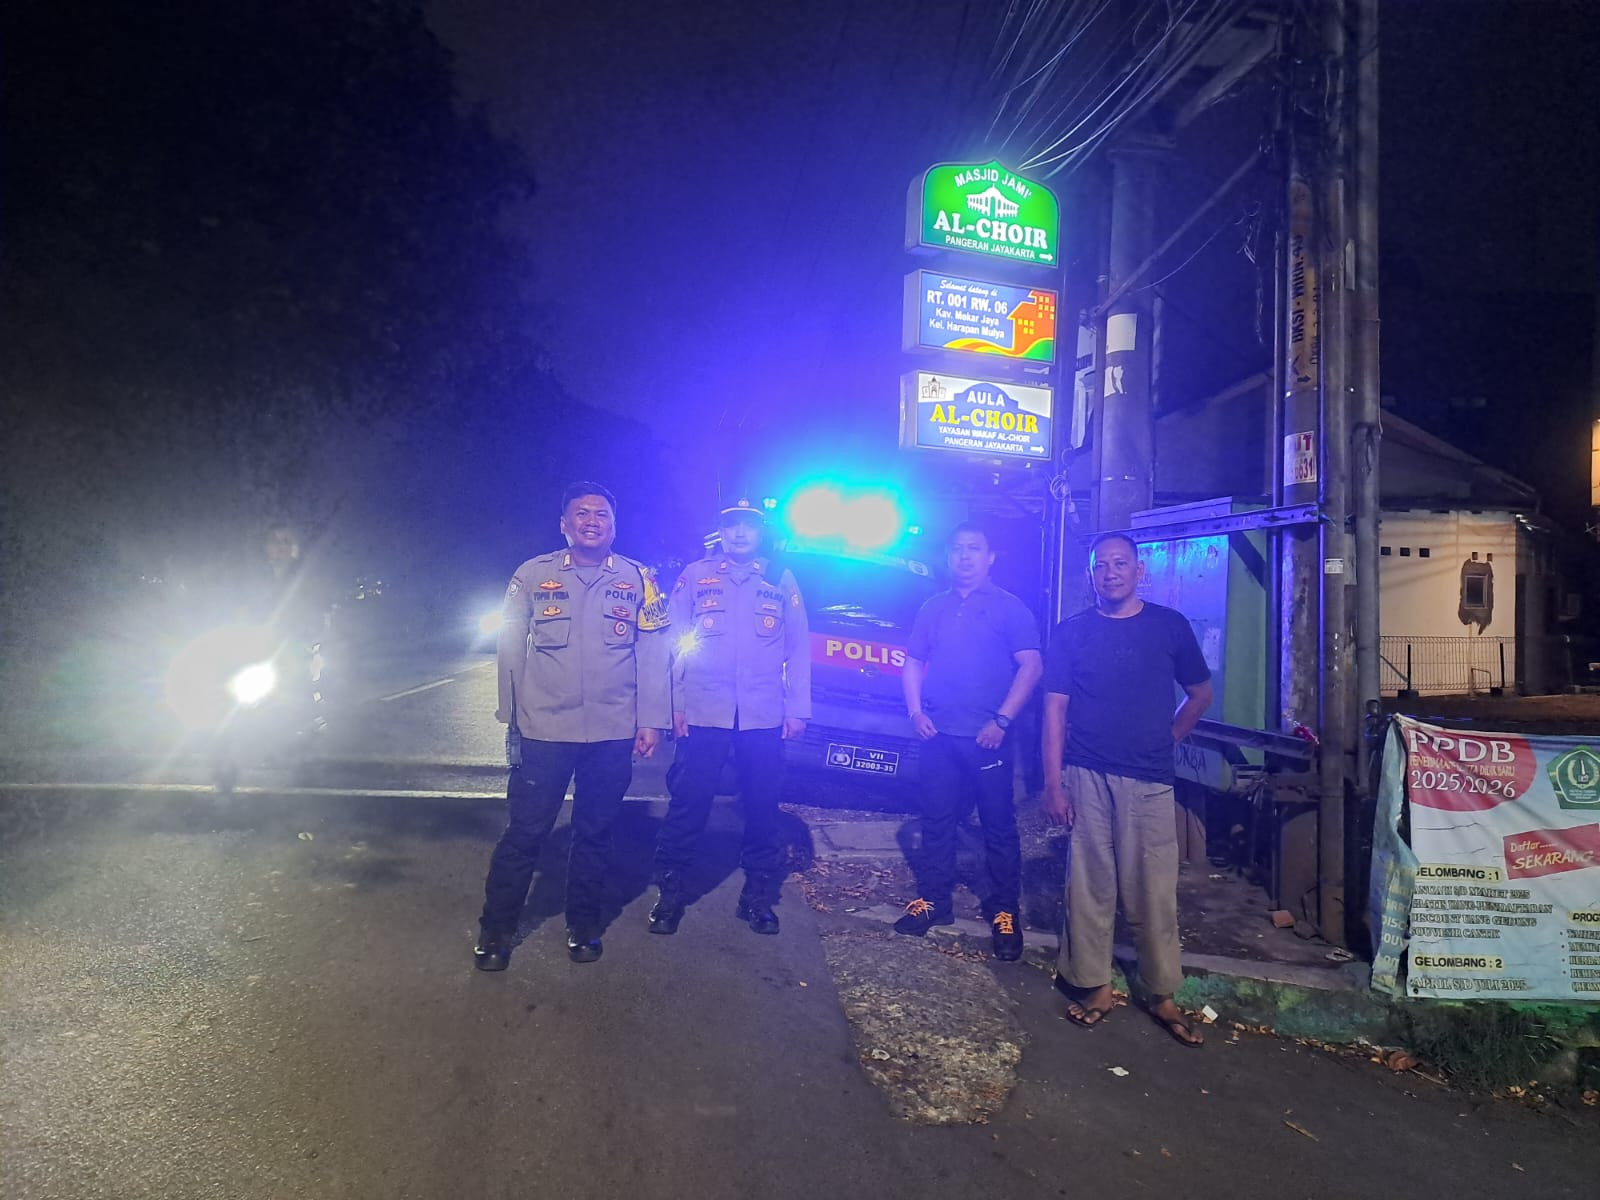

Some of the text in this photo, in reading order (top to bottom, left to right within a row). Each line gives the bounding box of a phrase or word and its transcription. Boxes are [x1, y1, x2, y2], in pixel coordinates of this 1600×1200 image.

[954, 168, 999, 187] MASJID
[933, 210, 1048, 249] AL-CHOIR
[945, 234, 1035, 259] PANGERAN JAYAKARTA
[927, 289, 1008, 315] RT. 001 RW. 06
[935, 307, 952, 319] Kav.
[980, 315, 999, 327] Jaya
[929, 318, 1005, 340] Kel. Harapan Mulya
[966, 390, 1005, 407] AULA
[929, 403, 1039, 434] AL-CHOIR
[938, 425, 1030, 444] YAYASAN WAKAF AL-CHOIR
[944, 436, 1024, 453] PANGERAN JAYAKARTA
[605, 589, 637, 602] POLRI
[1408, 729, 1516, 763] PPDB
[1411, 769, 1516, 798] 2025/2026
[1512, 849, 1594, 870] SEKARANG
[1415, 957, 1486, 967] GELOMBANG
